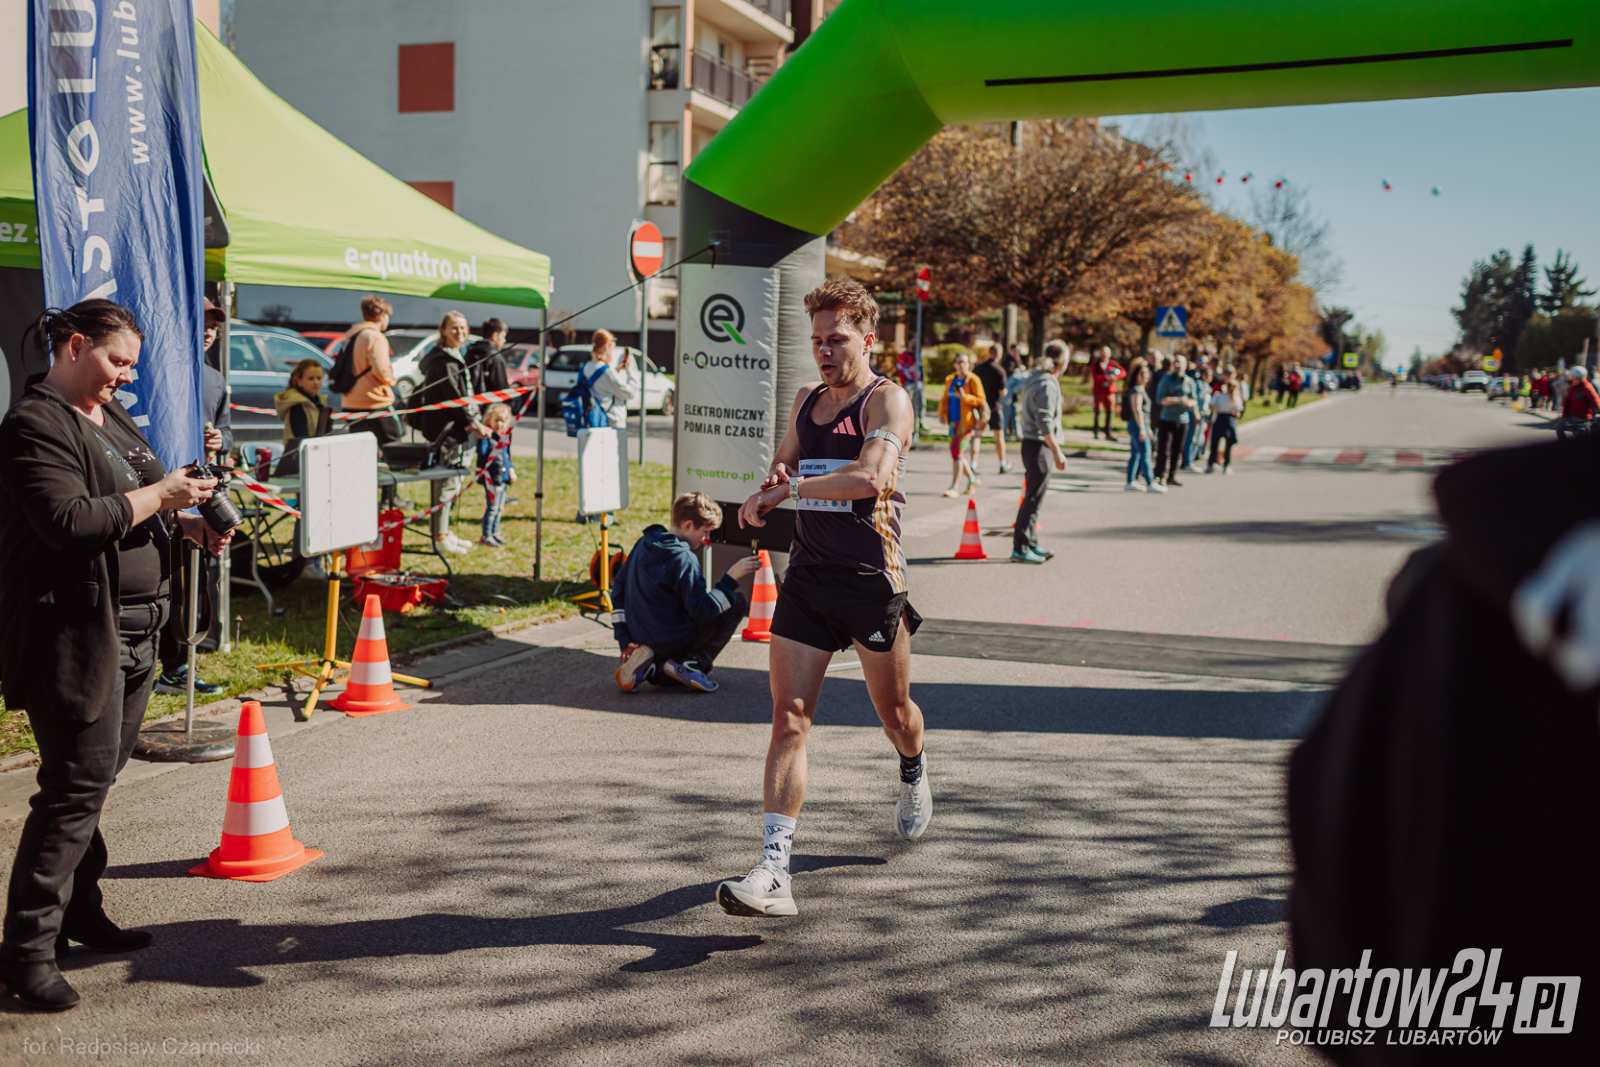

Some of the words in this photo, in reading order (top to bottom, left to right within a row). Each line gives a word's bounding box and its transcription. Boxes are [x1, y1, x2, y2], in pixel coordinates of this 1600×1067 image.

[343, 246, 477, 290] e-quattro.pl
[684, 403, 765, 421] ELEKTRONICZNY
[684, 420, 720, 435] POMIAR
[725, 424, 764, 438] CZASU
[687, 466, 755, 482] e-quattro.pl
